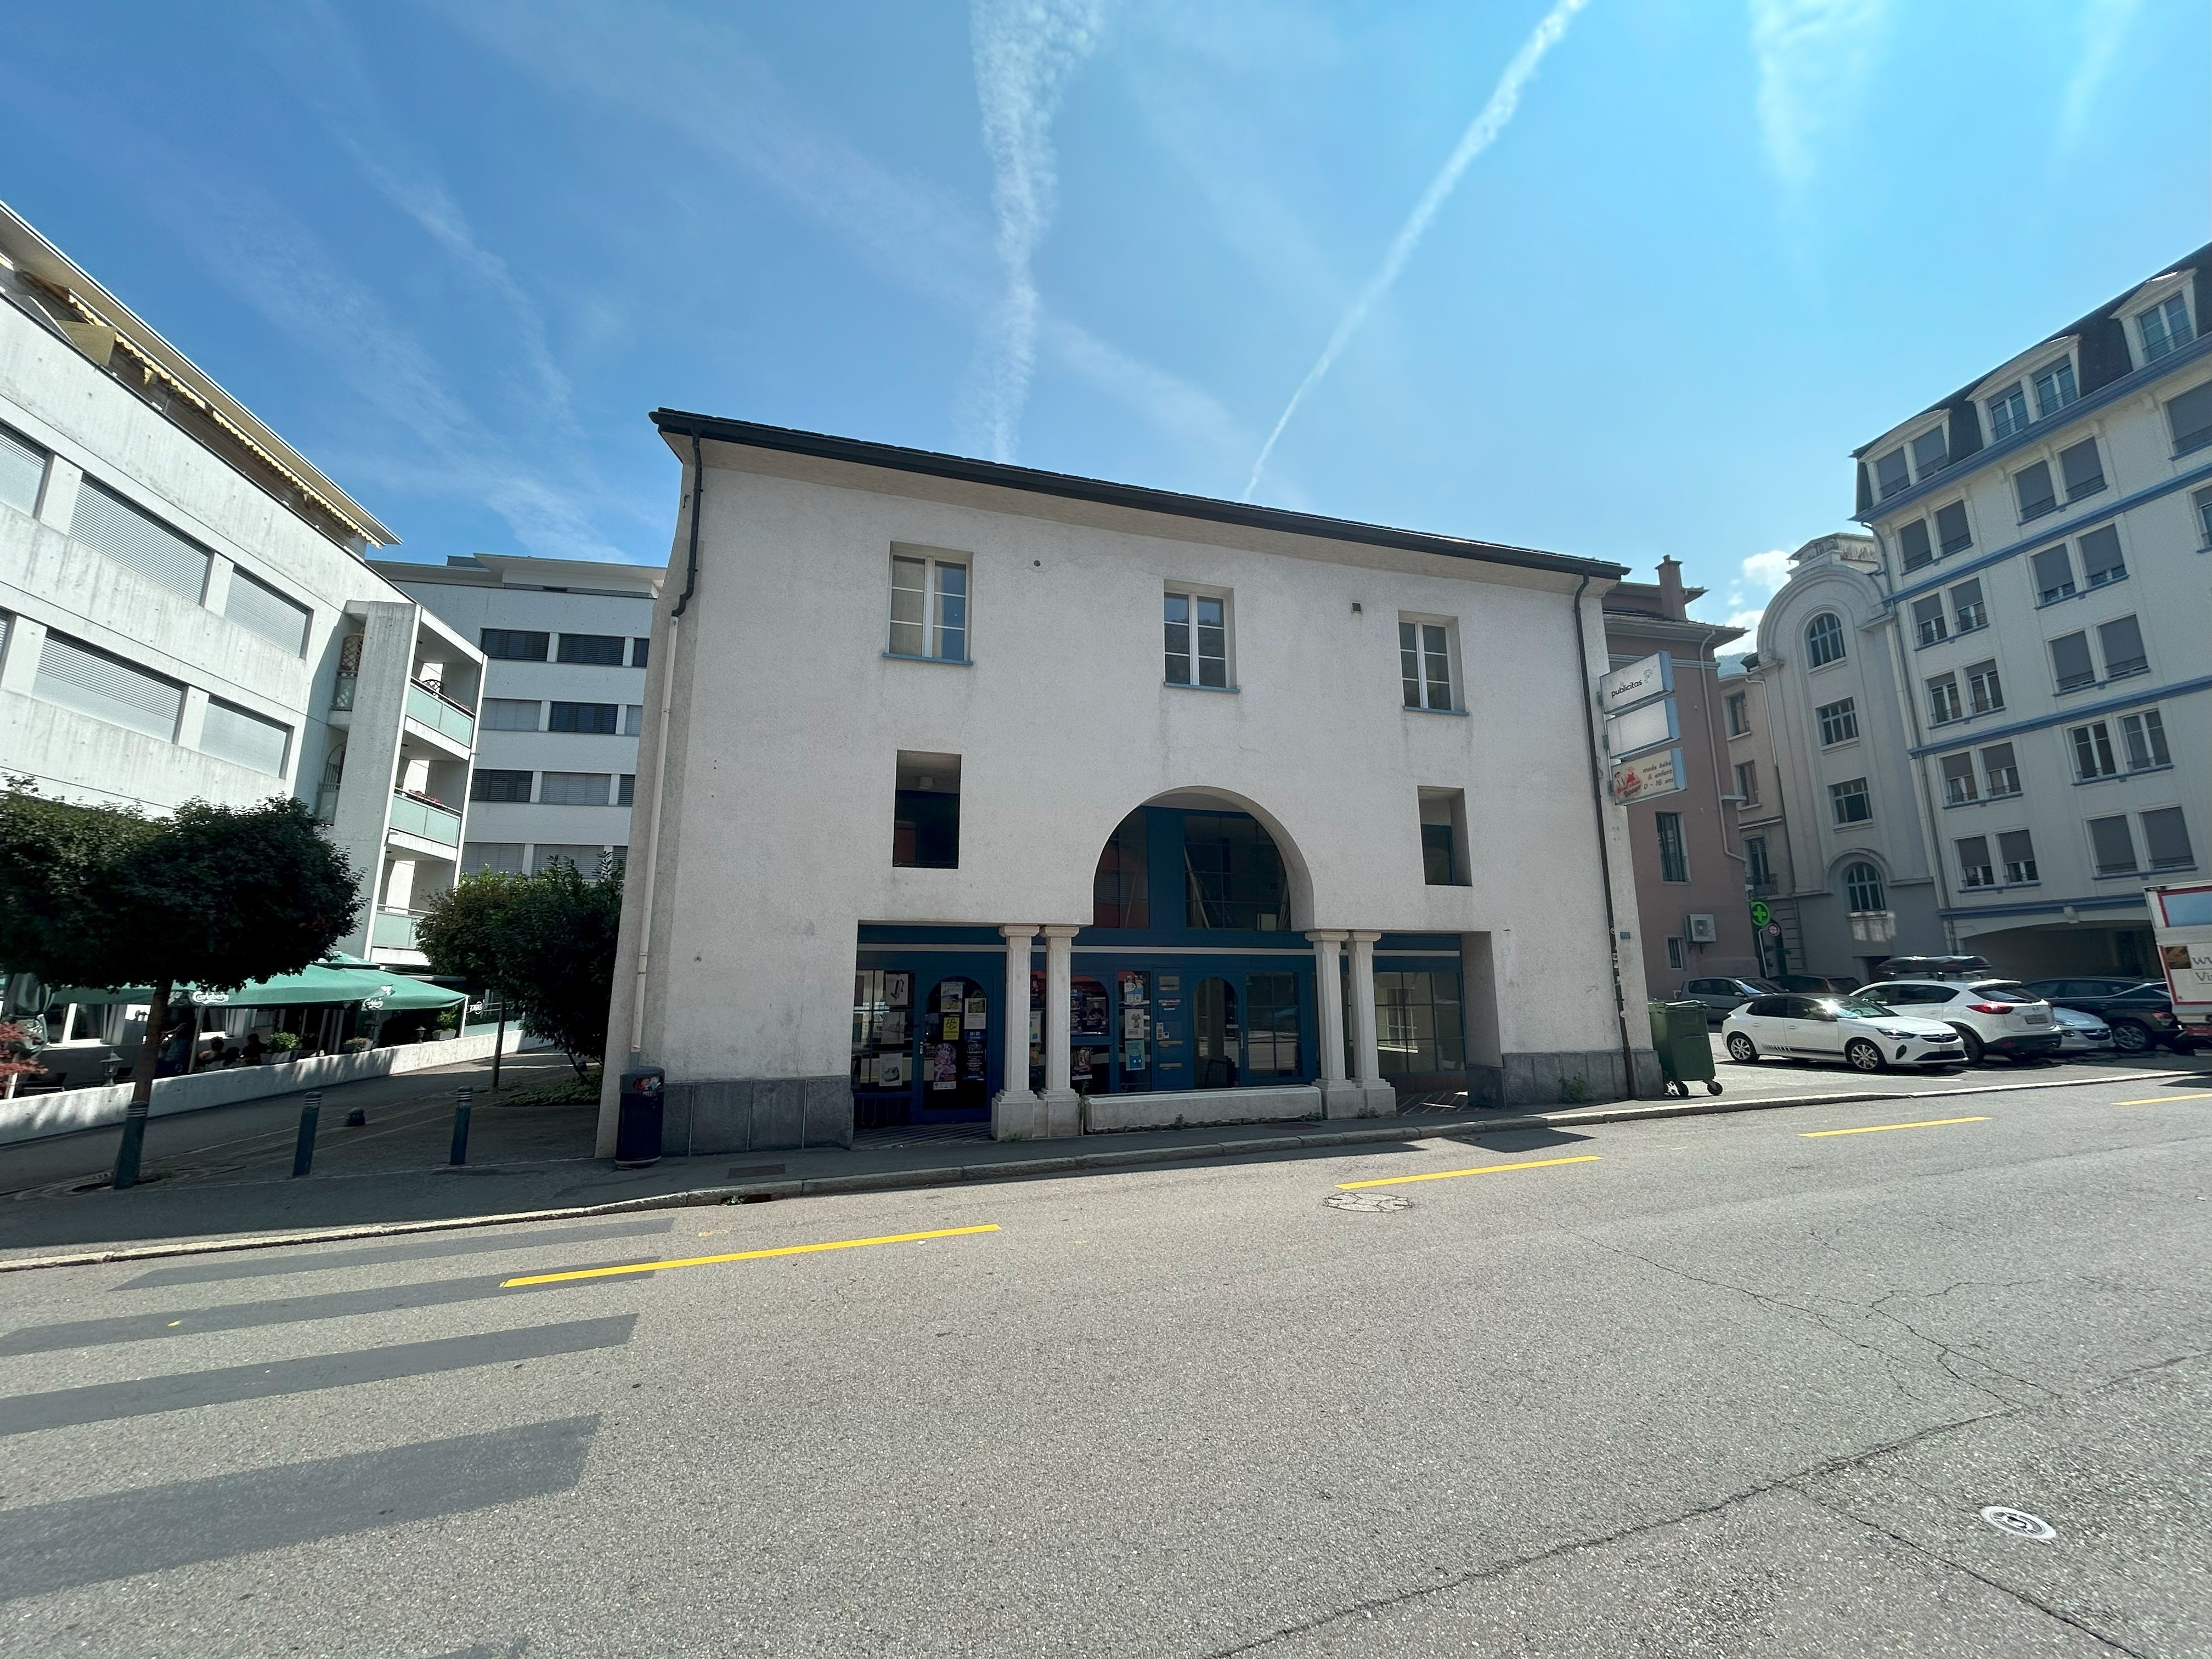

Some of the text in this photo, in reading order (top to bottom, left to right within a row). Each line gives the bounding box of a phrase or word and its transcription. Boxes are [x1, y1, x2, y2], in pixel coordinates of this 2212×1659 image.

[1611, 680, 1643, 698] publicitas
[1643, 760, 1672, 773] mode bébé
[1655, 769, 1673, 778] enfant
[193, 990, 229, 1005] Carlsberg
